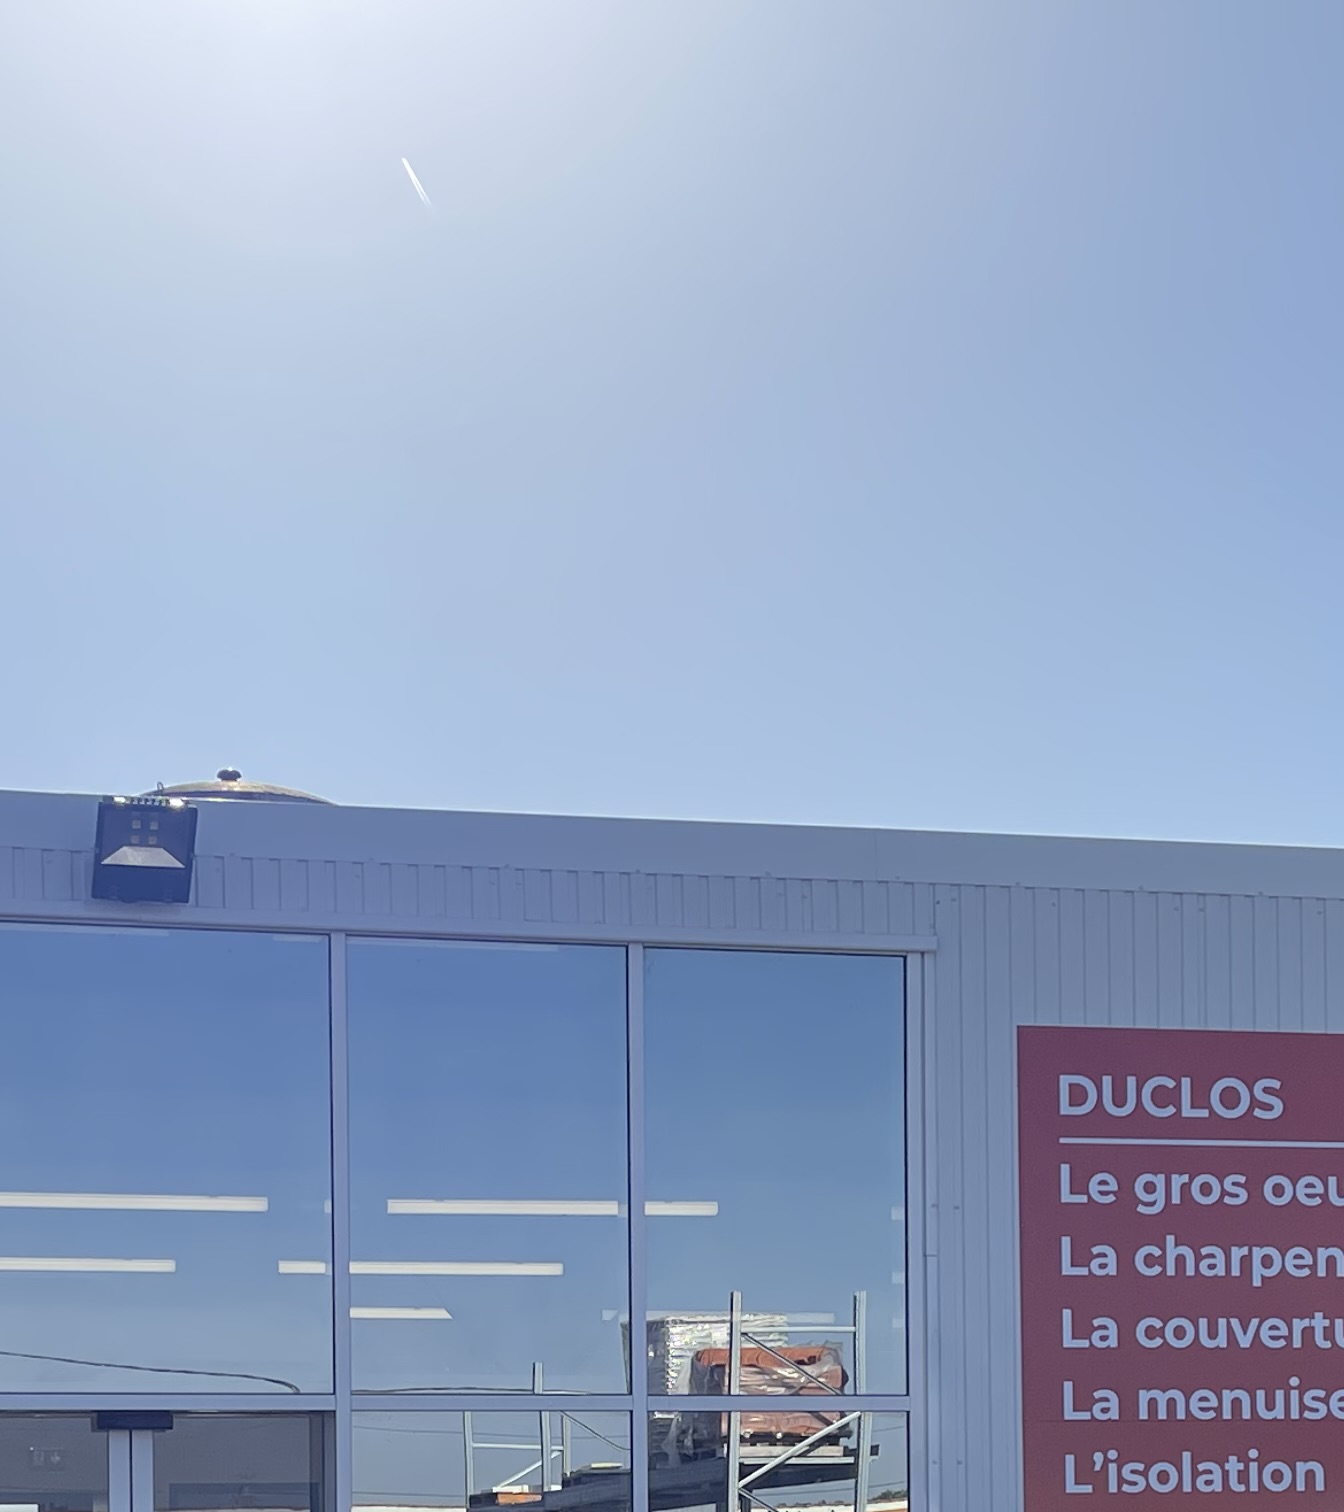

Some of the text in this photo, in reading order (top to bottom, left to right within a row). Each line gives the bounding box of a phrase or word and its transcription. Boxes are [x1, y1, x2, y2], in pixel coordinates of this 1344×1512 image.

[1058, 1074, 1285, 1120] DUCLOS
[1060, 1163, 1119, 1204] Le
[1134, 1171, 1248, 1215] gros
[1060, 1236, 1118, 1276] La
[1061, 1308, 1119, 1348] La
[1062, 1380, 1120, 1421] La
[1064, 1448, 1326, 1494] L’isolation
